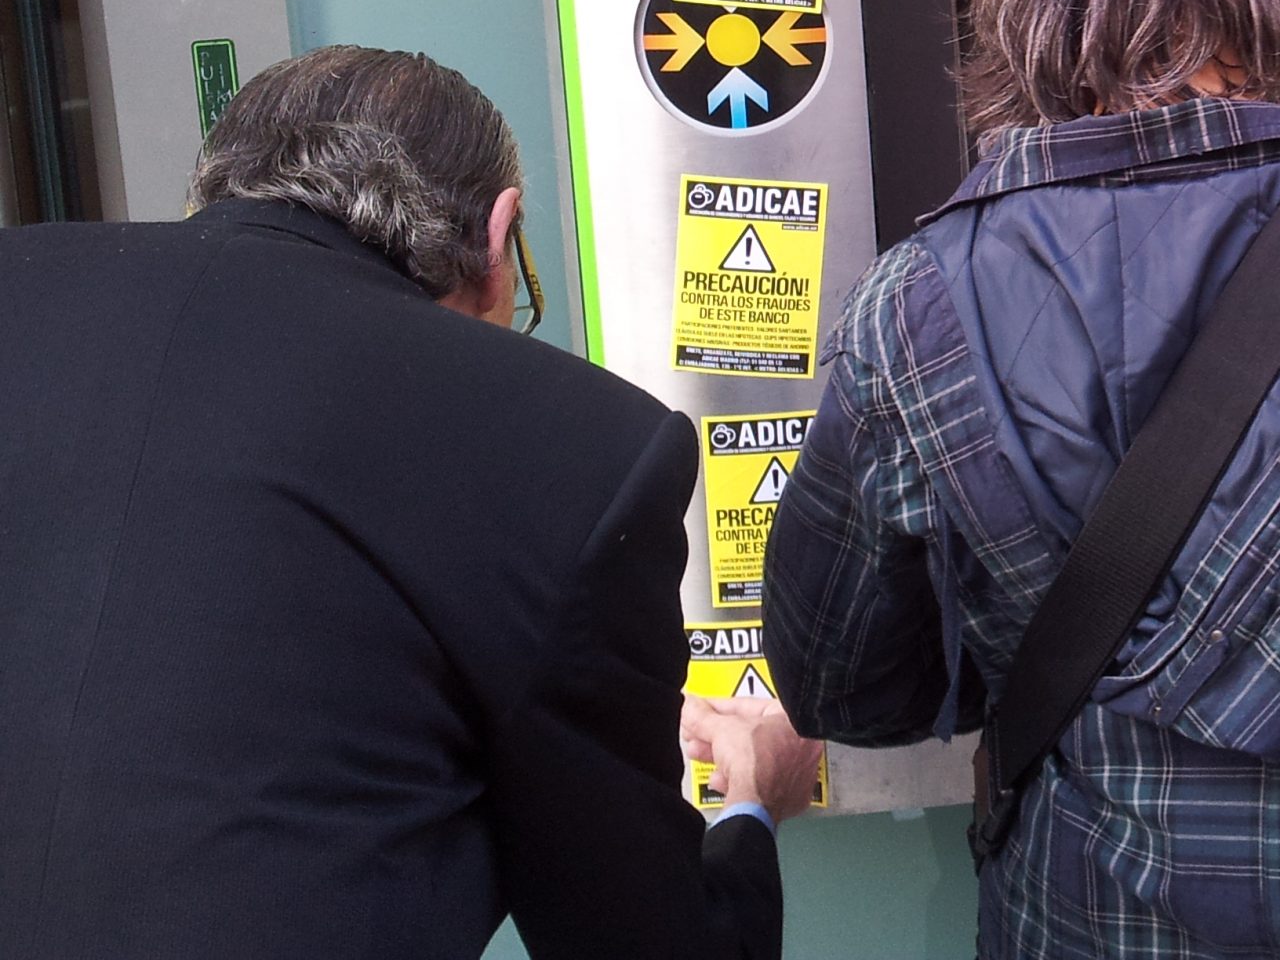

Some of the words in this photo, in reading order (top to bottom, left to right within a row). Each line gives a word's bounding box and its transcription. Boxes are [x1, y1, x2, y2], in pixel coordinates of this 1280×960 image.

[714, 184, 818, 216] ADICAE
[682, 270, 809, 297] PRECAUCIÓN!
[679, 291, 728, 307] CONTRA
[730, 295, 753, 308] LOS
[755, 296, 810, 312] FRAUDES
[698, 306, 714, 320] DE
[716, 308, 746, 322] ESTE
[748, 310, 790, 324] BANCO
[738, 417, 813, 448] ADIC
[715, 528, 763, 542] CONTRA
[736, 543, 751, 555] DE
[753, 541, 767, 554] ES
[713, 627, 763, 656] ADI
